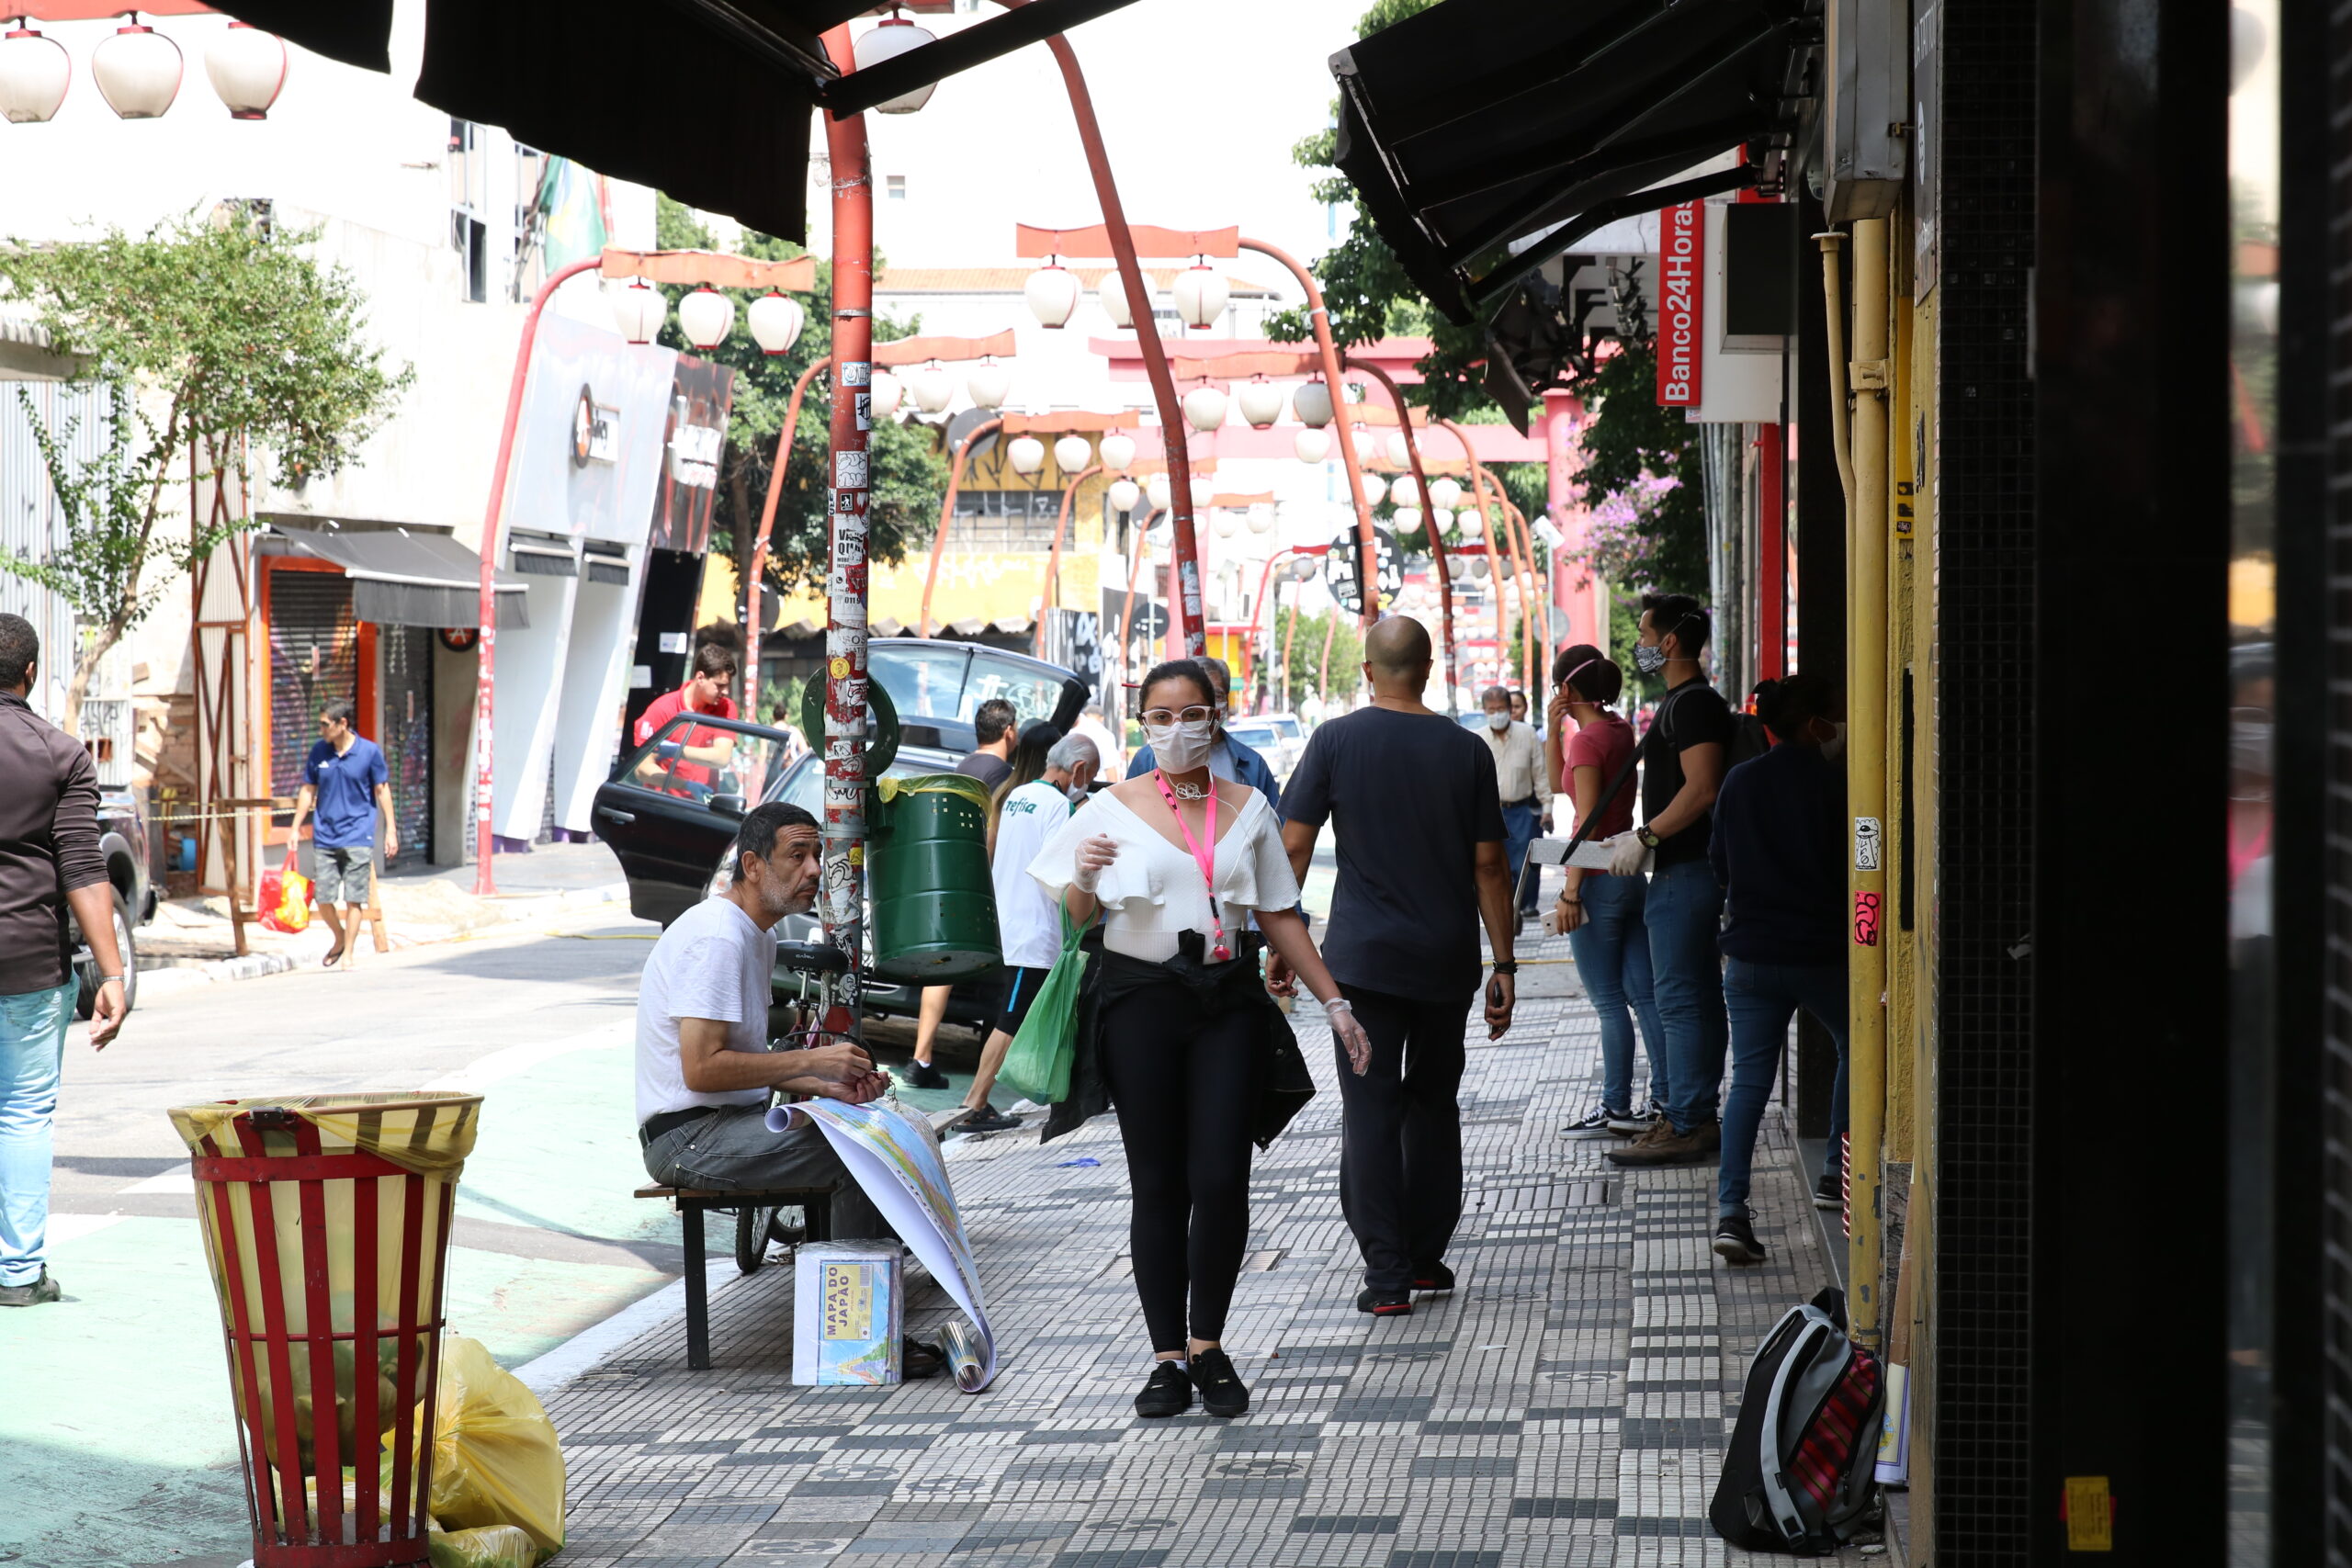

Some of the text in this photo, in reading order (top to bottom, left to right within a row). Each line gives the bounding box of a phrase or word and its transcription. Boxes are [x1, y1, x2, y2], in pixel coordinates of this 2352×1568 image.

[827, 1267, 838, 1336] MAPA DO
[838, 1275, 850, 1327] JAPÃO
